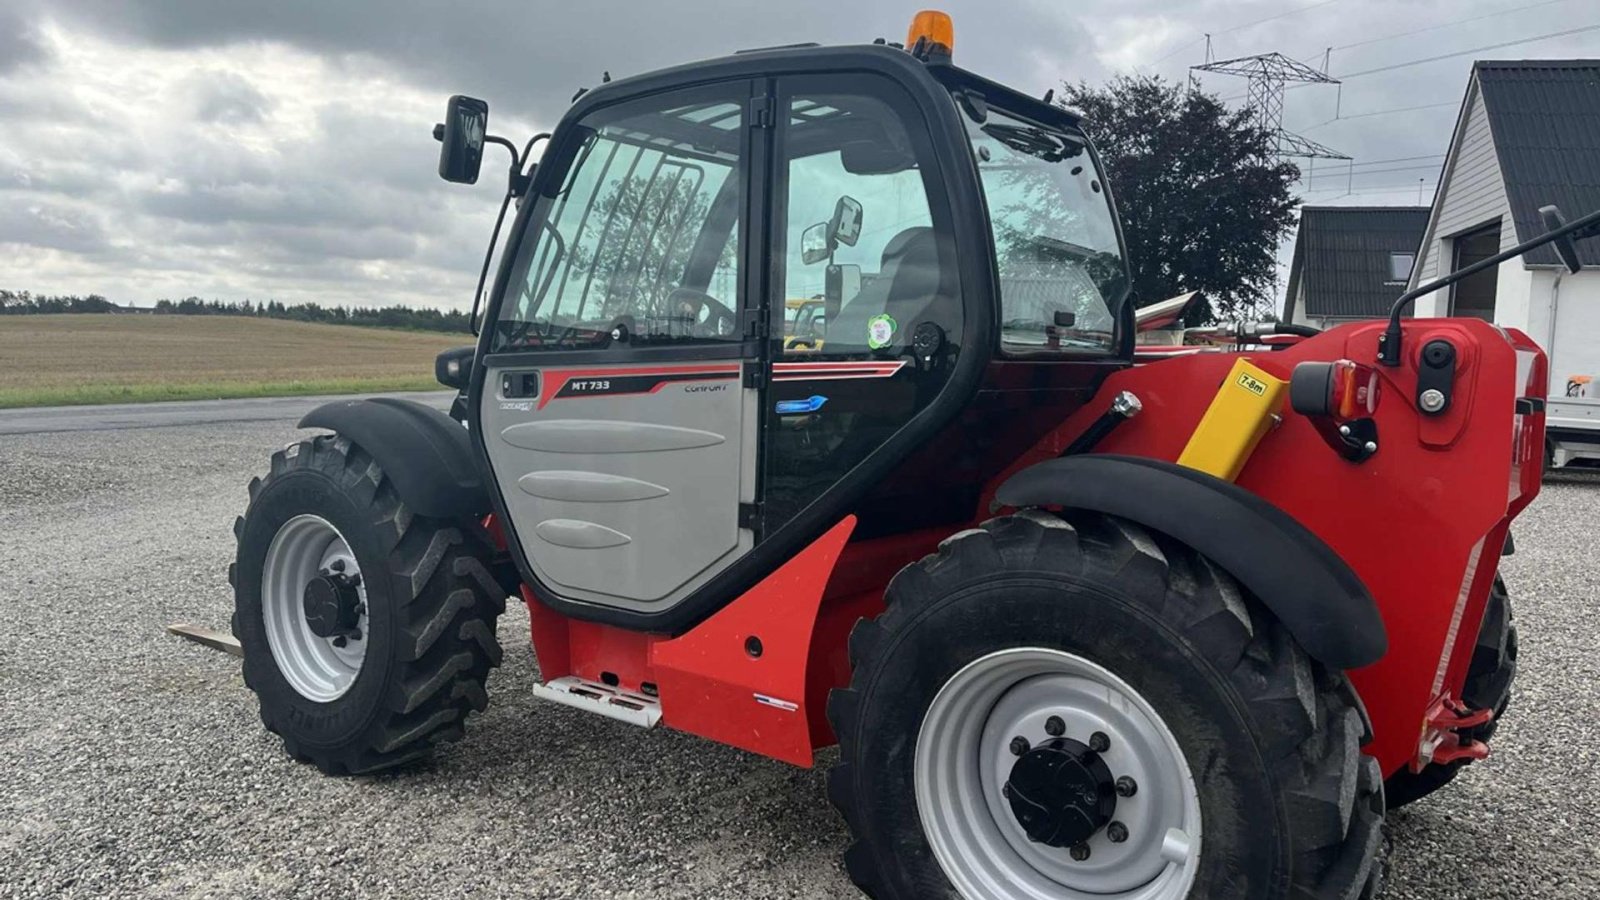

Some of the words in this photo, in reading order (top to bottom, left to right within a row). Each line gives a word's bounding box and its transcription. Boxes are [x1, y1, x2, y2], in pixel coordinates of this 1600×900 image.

[572, 382, 588, 390] MT
[590, 381, 610, 390] 733
[1241, 375, 1263, 393] 7-8m
